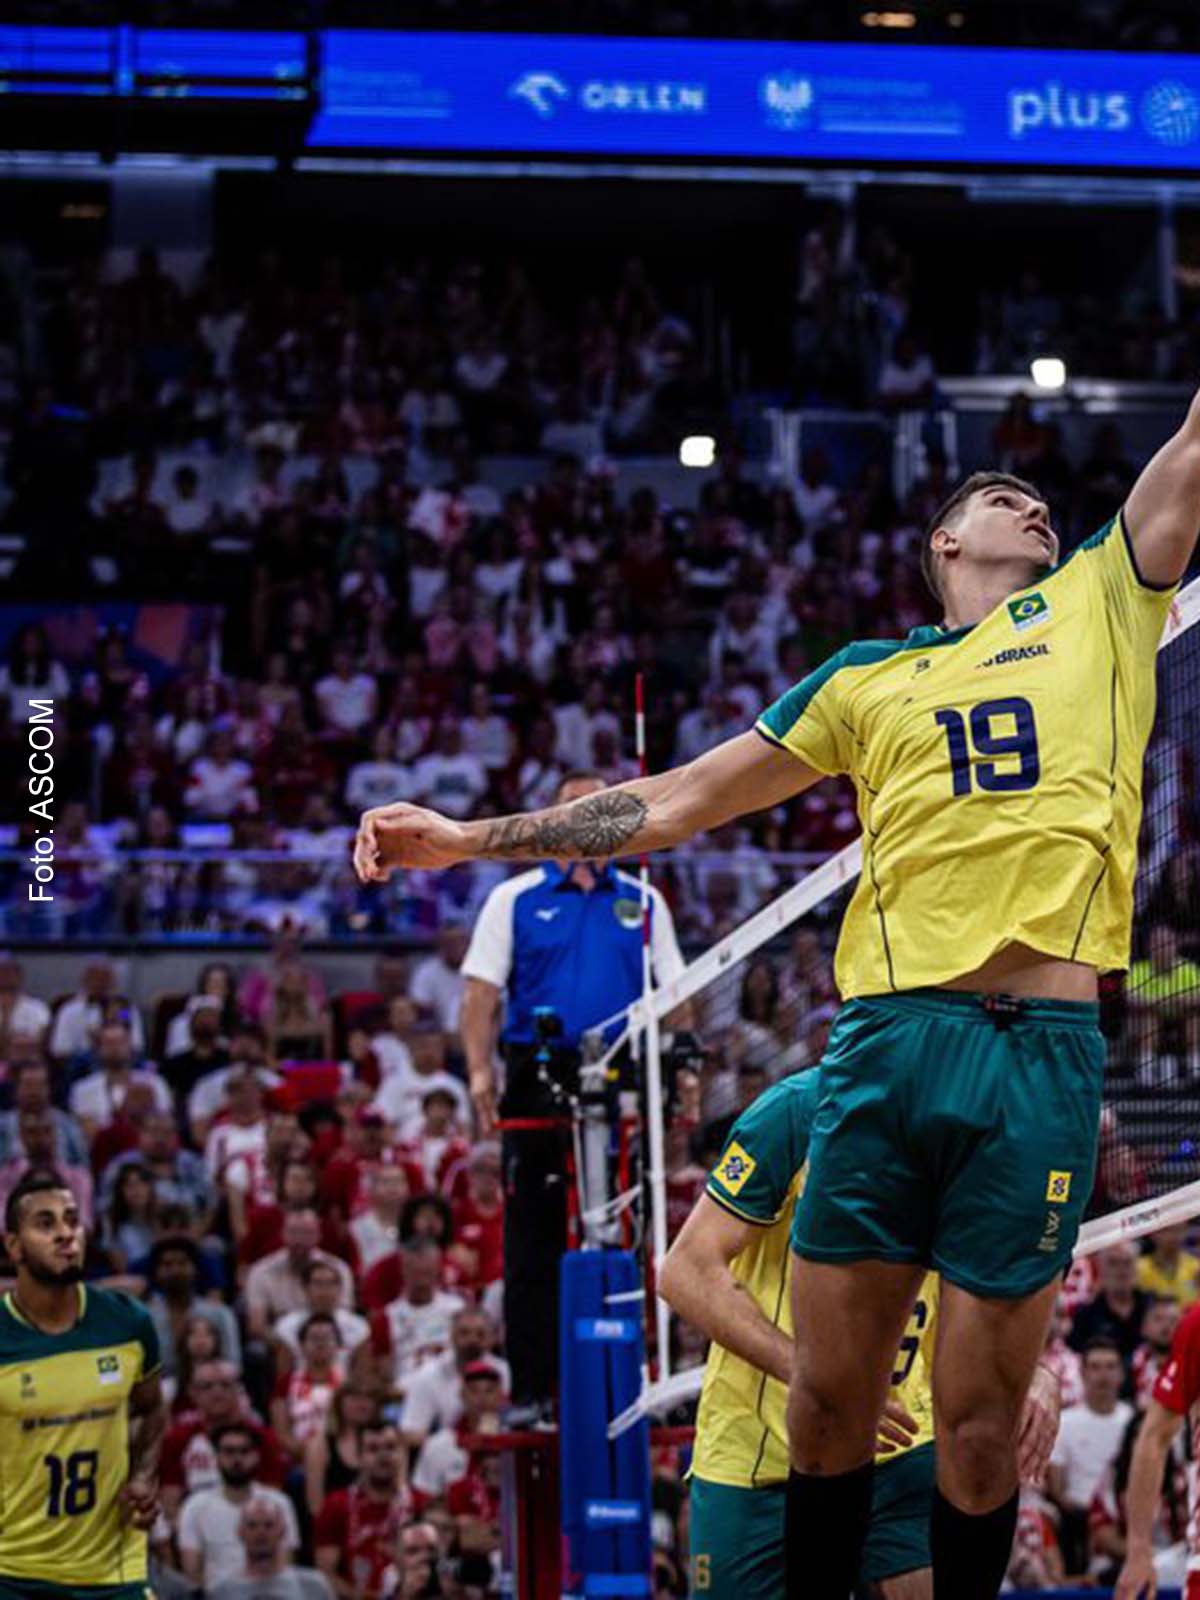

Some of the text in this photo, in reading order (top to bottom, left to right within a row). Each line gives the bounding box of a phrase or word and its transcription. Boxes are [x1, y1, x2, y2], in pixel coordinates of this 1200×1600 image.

[583, 82, 706, 111] ORLEN
[1008, 79, 1130, 136] plus
[934, 696, 1041, 797] 19
[44, 1451, 98, 1518] 18
